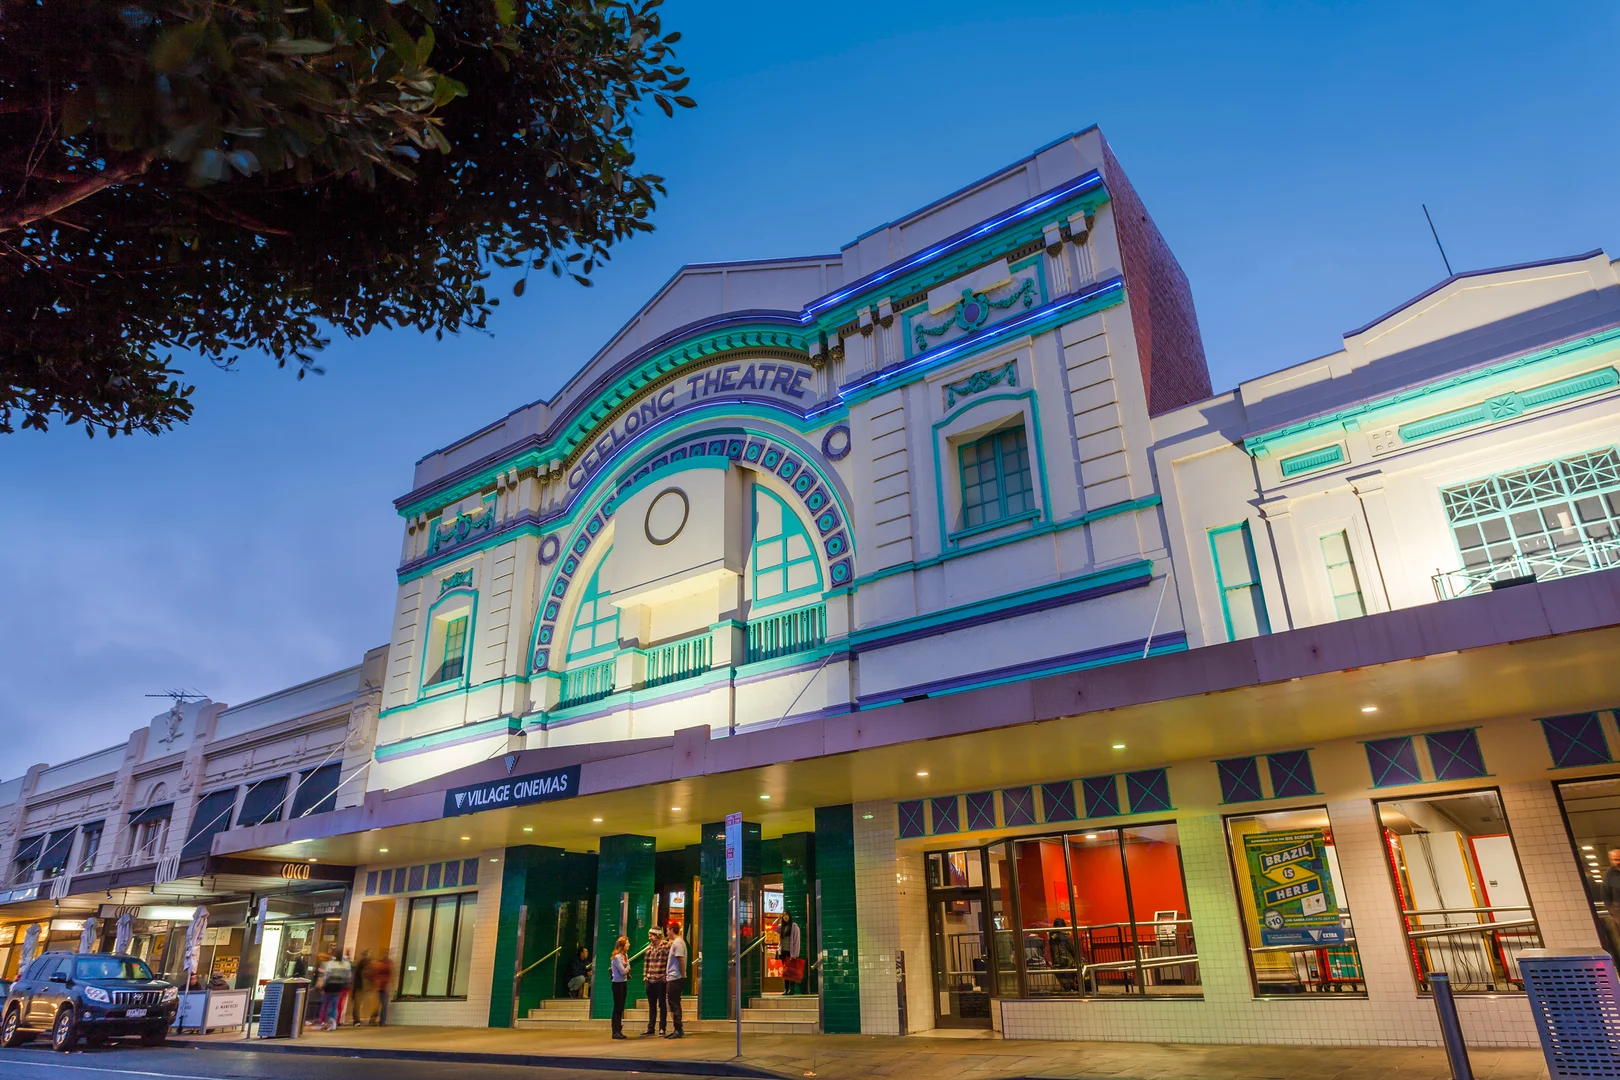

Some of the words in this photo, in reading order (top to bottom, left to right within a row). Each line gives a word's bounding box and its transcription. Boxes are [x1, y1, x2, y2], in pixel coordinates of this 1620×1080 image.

[568, 385, 676, 490] GEELONG
[686, 362, 814, 400] THEATRE
[468, 784, 511, 807] VILLAGE
[513, 774, 568, 799] CINEMAS
[1265, 846, 1310, 866] BRAZIL
[282, 863, 310, 880] COCCO
[1284, 869, 1294, 878] IS
[1276, 883, 1309, 900] HERE
[1267, 917, 1282, 927] $10
